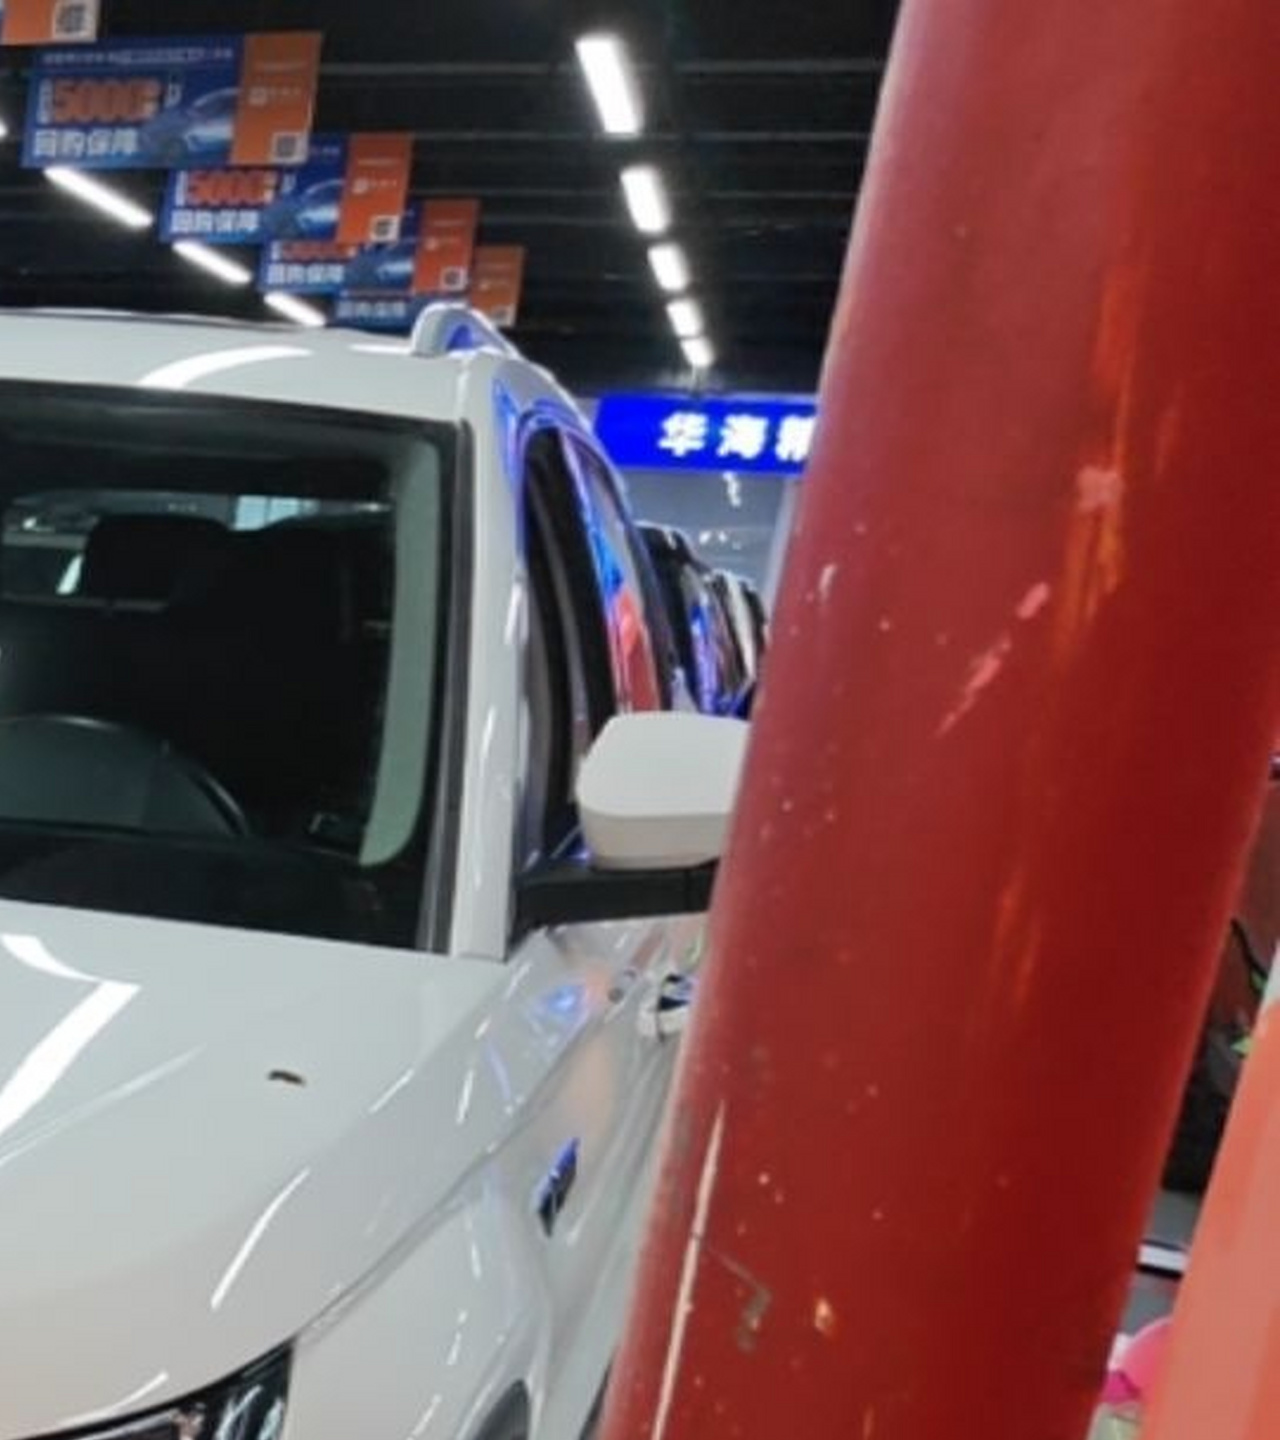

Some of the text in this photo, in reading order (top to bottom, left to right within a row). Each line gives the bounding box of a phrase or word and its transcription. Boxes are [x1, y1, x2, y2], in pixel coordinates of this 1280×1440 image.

[33, 127, 140, 158] 回购保障
[170, 209, 260, 235] 回购保障
